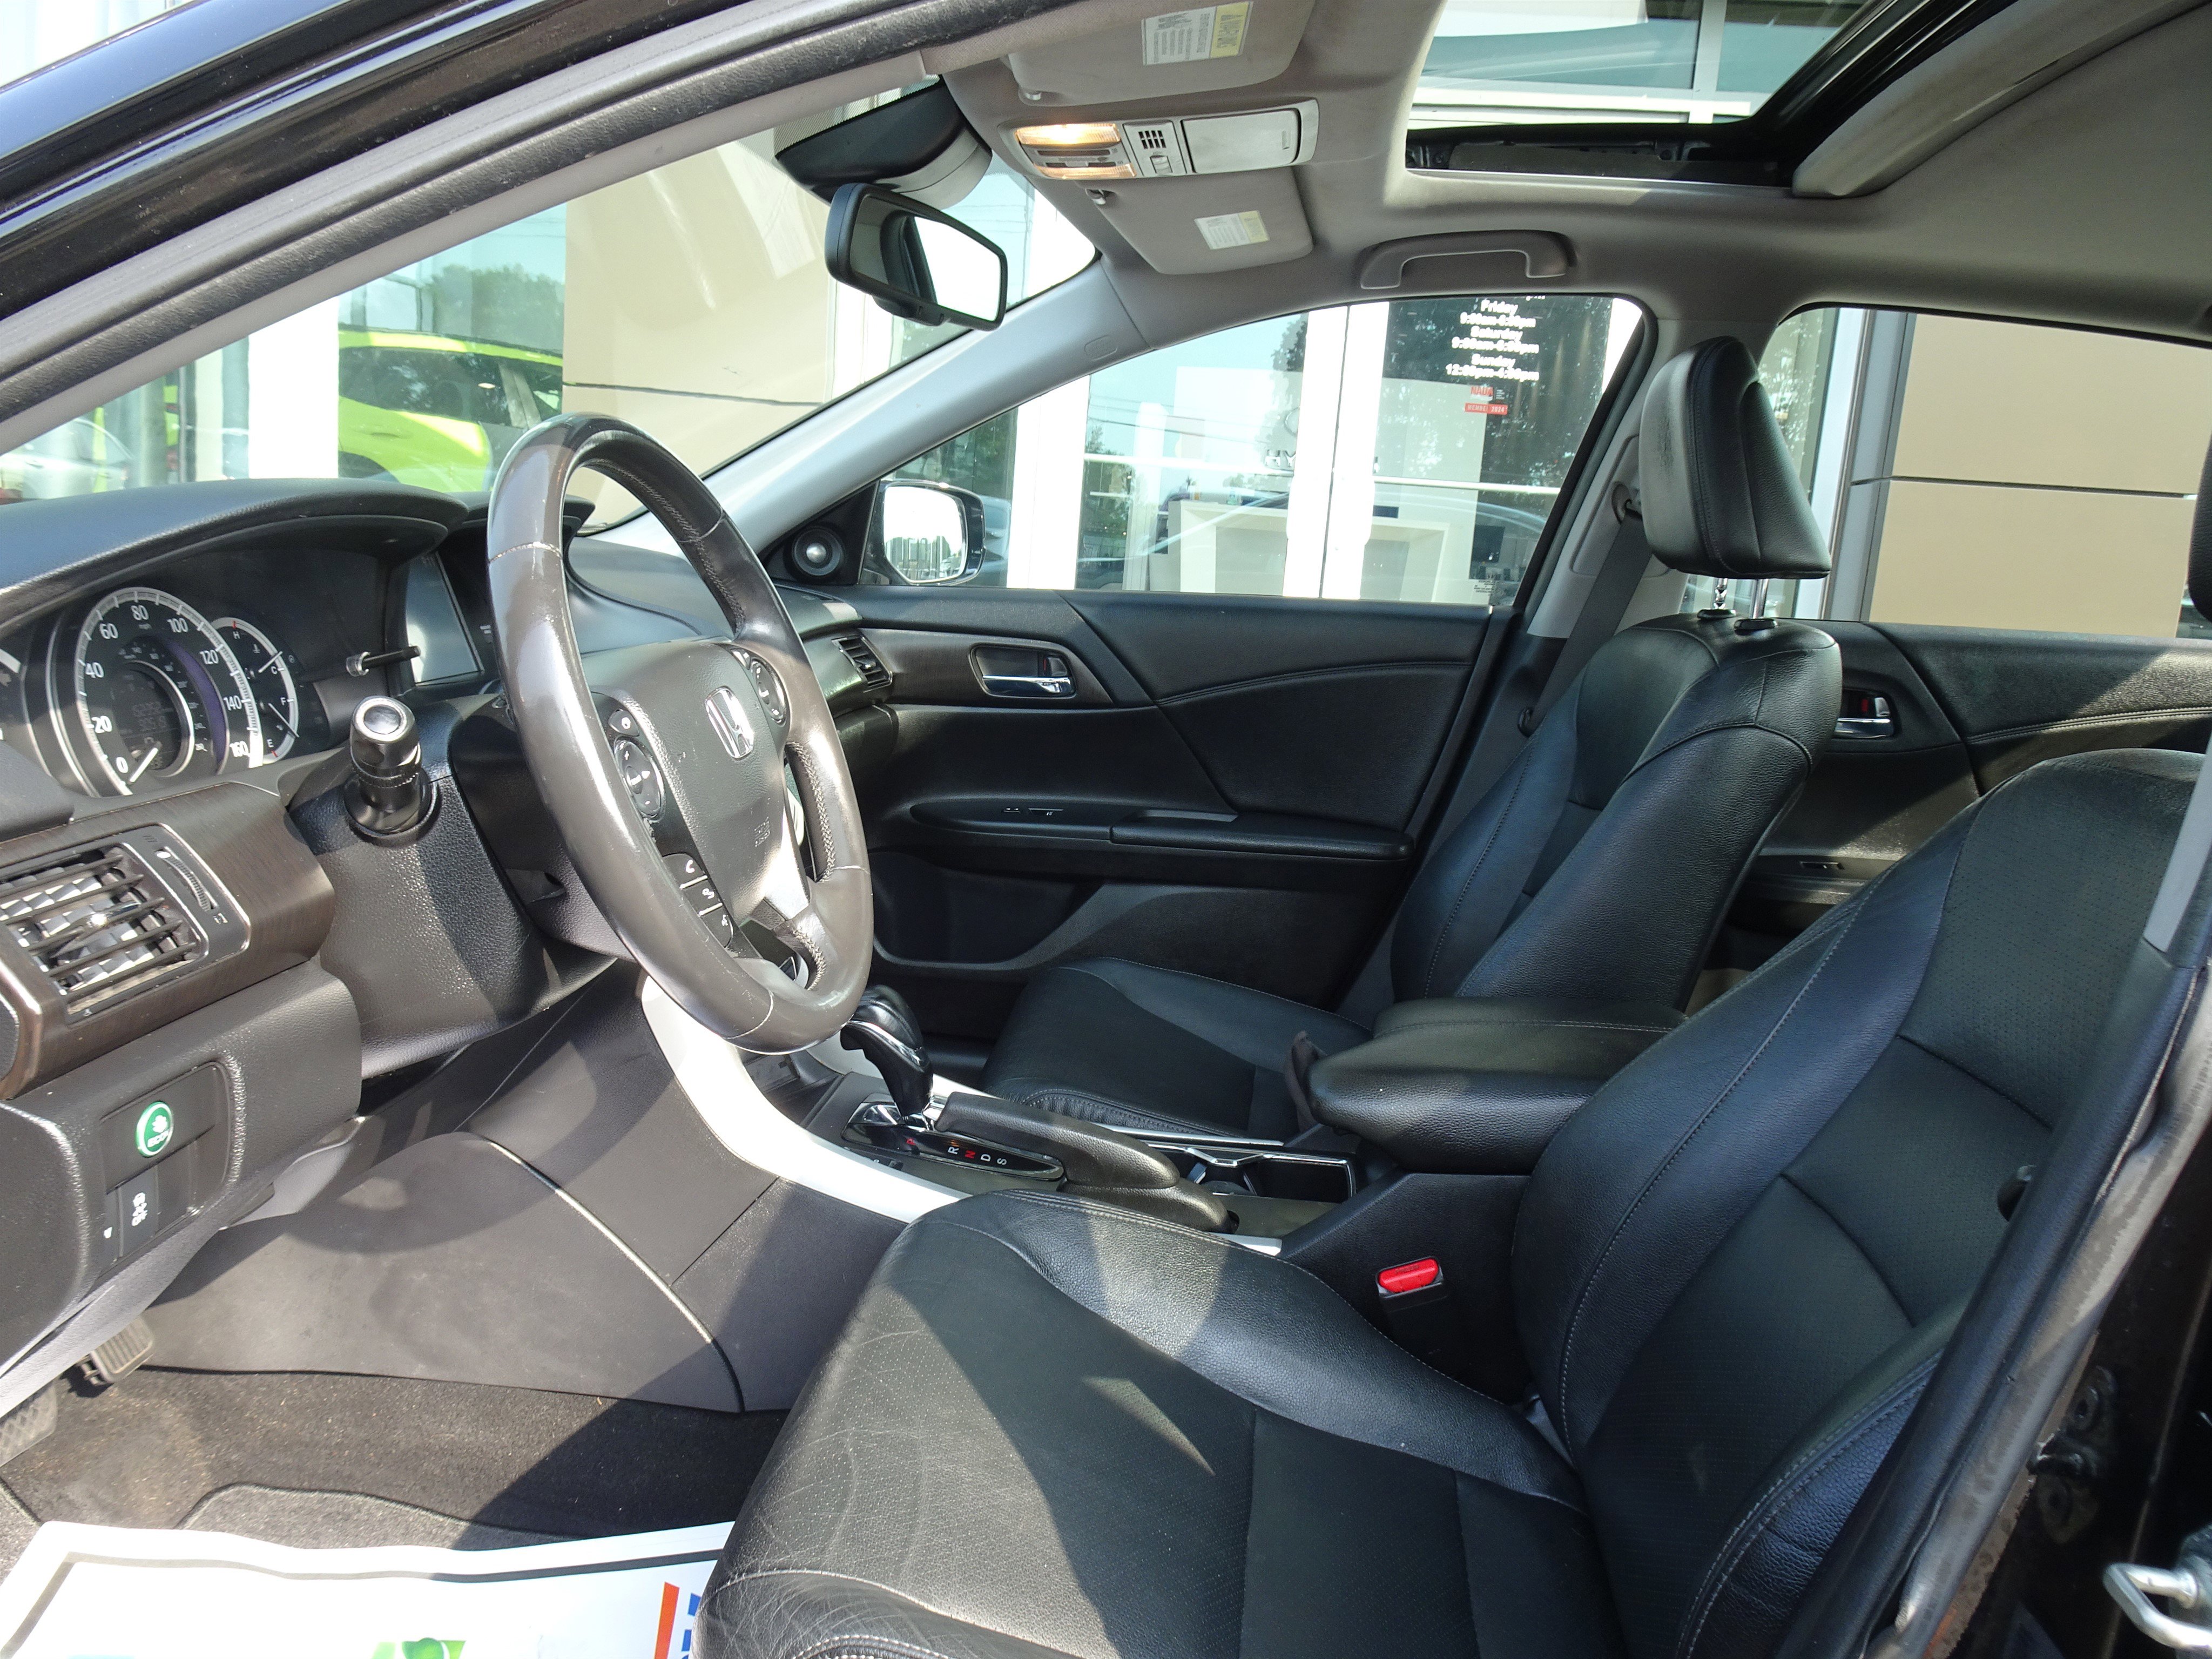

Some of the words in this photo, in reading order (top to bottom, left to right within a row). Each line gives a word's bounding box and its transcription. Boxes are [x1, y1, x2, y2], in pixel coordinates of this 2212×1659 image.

[1481, 300, 1518, 316] Friday
[1471, 326, 1523, 342] Saturday
[1471, 353, 1516, 369] Sunday
[131, 605, 149, 621] 80
[99, 623, 118, 639] 60
[167, 618, 188, 633] 100
[233, 631, 240, 639] H
[200, 649, 219, 664] 120
[85, 662, 104, 678] 40
[224, 695, 242, 711] 140
[280, 697, 286, 705] F
[91, 715, 112, 733] 20
[230, 741, 248, 757] 160
[267, 739, 274, 748] E
[116, 757, 129, 773] 0
[948, 1146, 959, 1155] R
[965, 1150, 976, 1159] N
[980, 1154, 991, 1162] D
